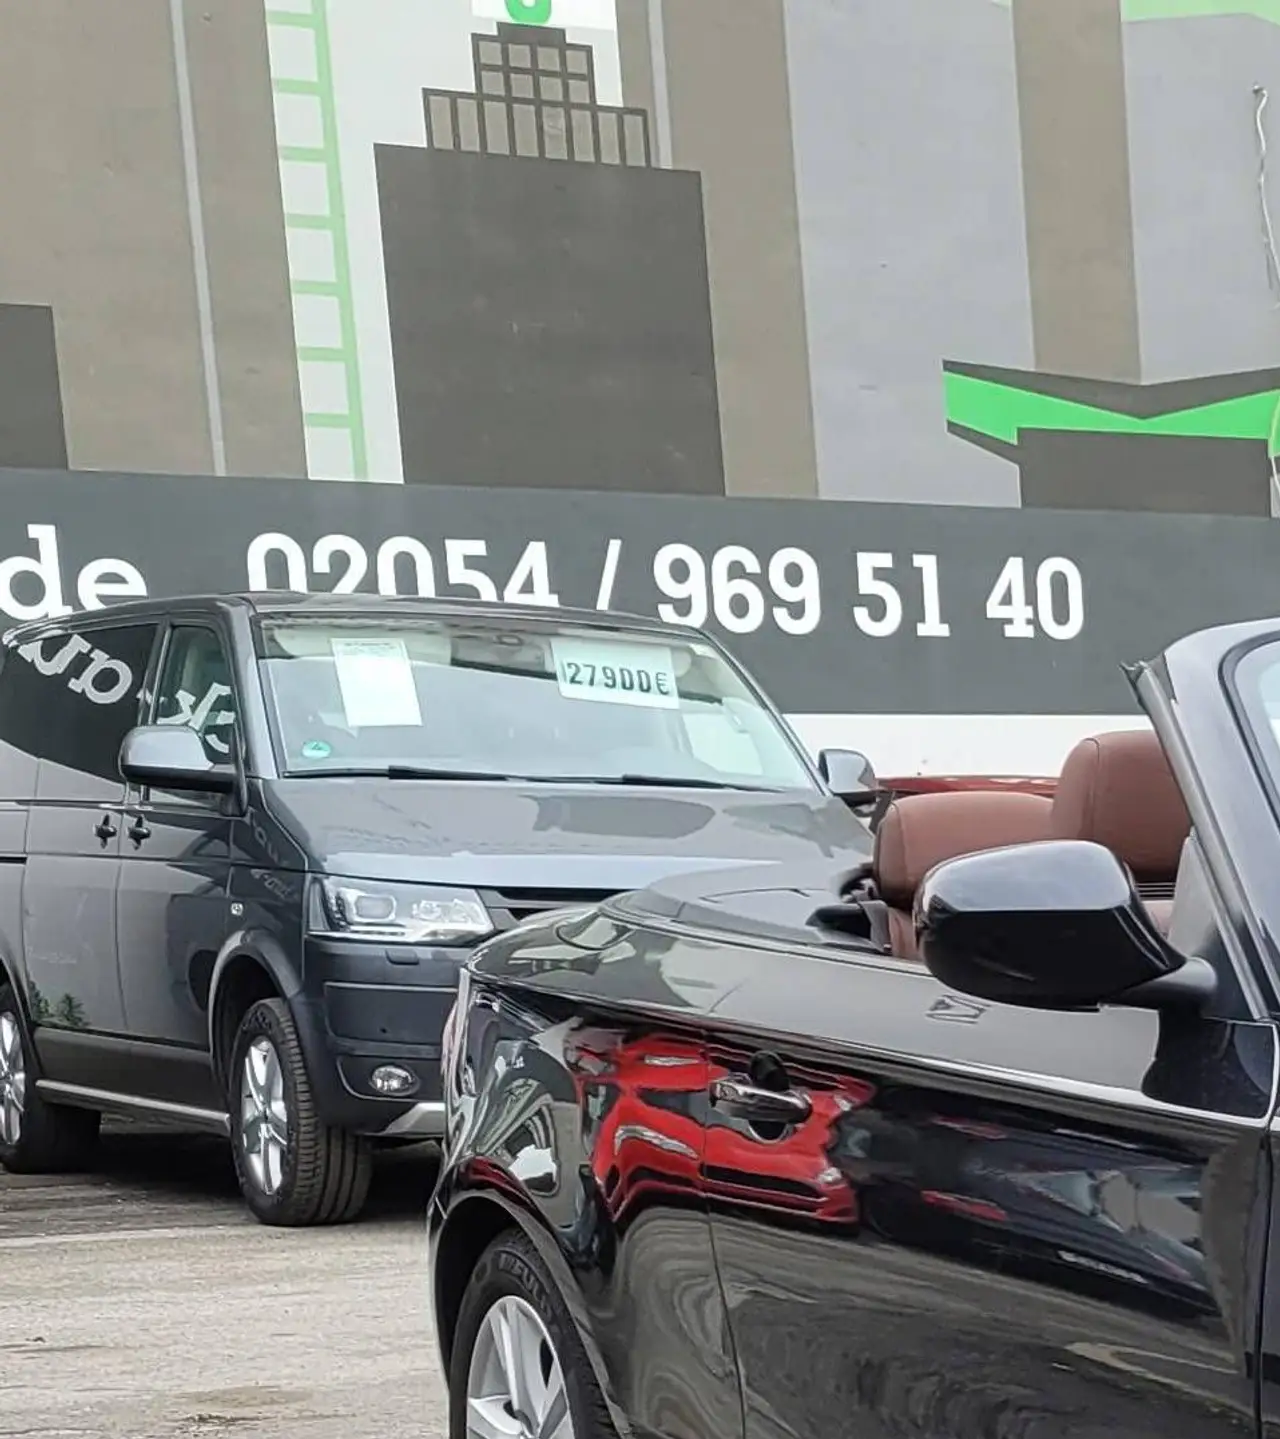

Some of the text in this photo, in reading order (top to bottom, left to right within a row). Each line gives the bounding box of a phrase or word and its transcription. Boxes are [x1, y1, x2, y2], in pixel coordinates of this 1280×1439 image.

[247, 532, 560, 608] 02054
[596, 538, 622, 611] /
[653, 543, 821, 636] 969
[853, 551, 951, 638] 51
[986, 556, 1085, 640] 40
